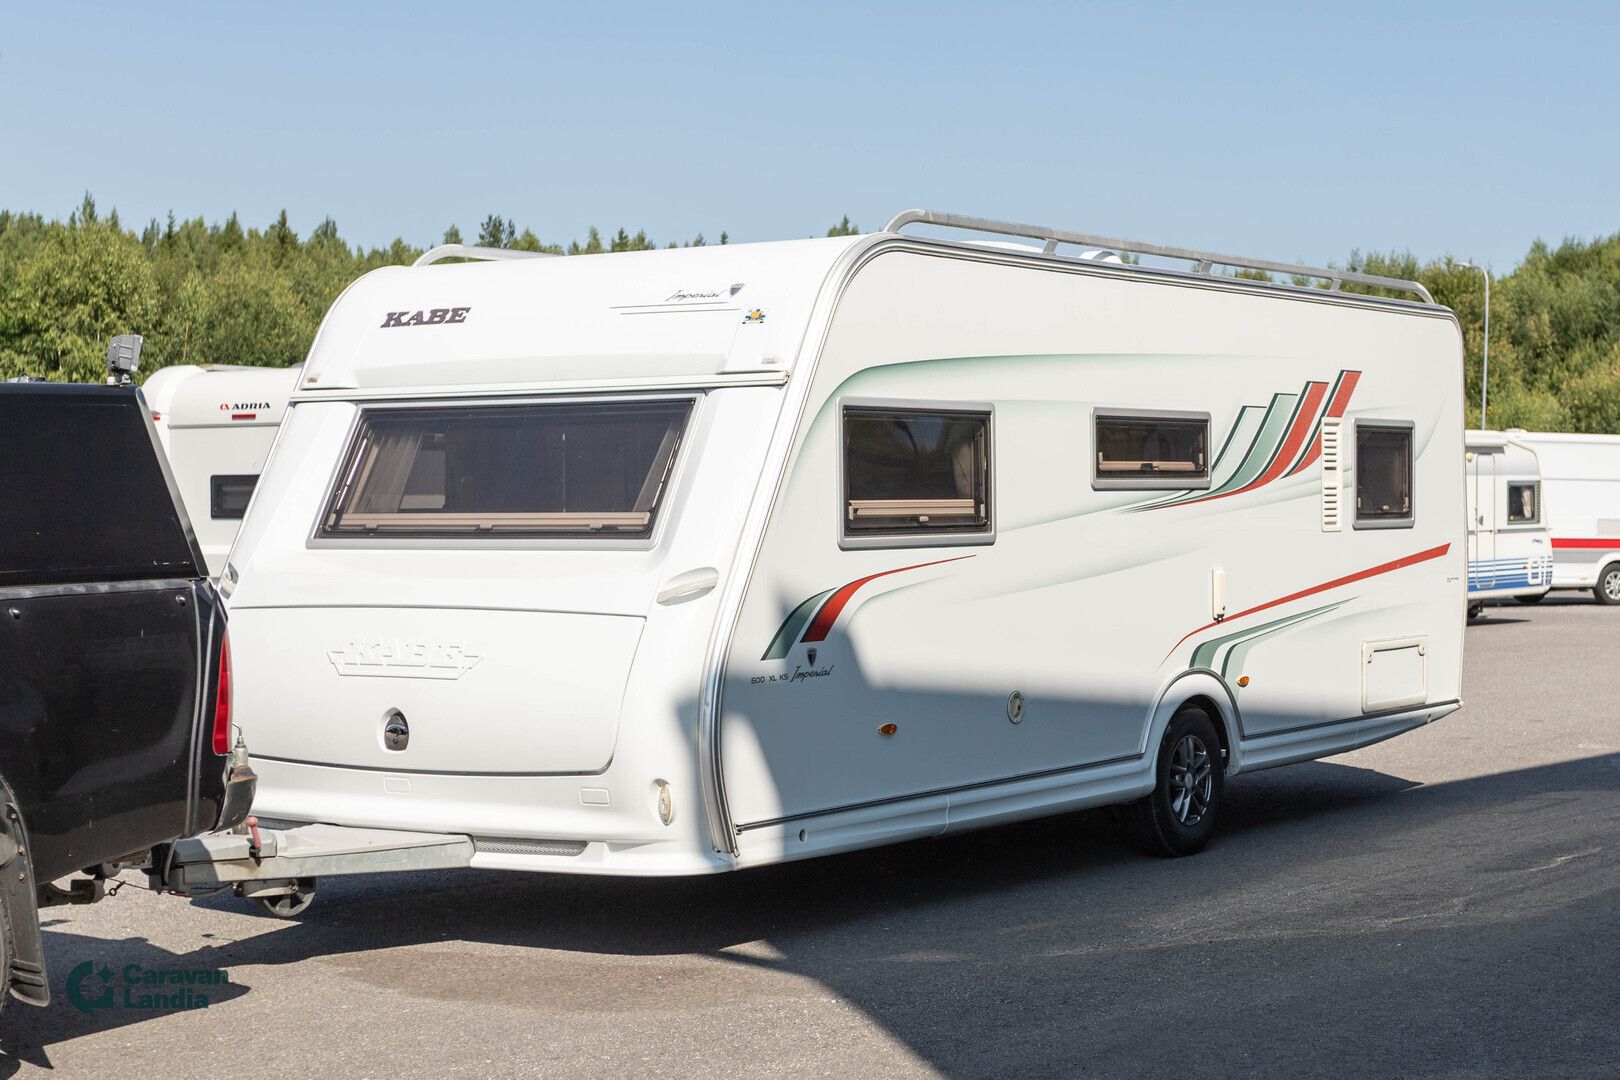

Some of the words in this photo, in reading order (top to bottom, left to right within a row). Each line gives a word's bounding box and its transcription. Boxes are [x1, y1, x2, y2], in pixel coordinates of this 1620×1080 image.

[664, 288, 728, 302] Imperial
[380, 307, 471, 328] KABE
[232, 402, 271, 410] ADRIA
[769, 675, 777, 683] XL
[790, 664, 834, 683] Imperial
